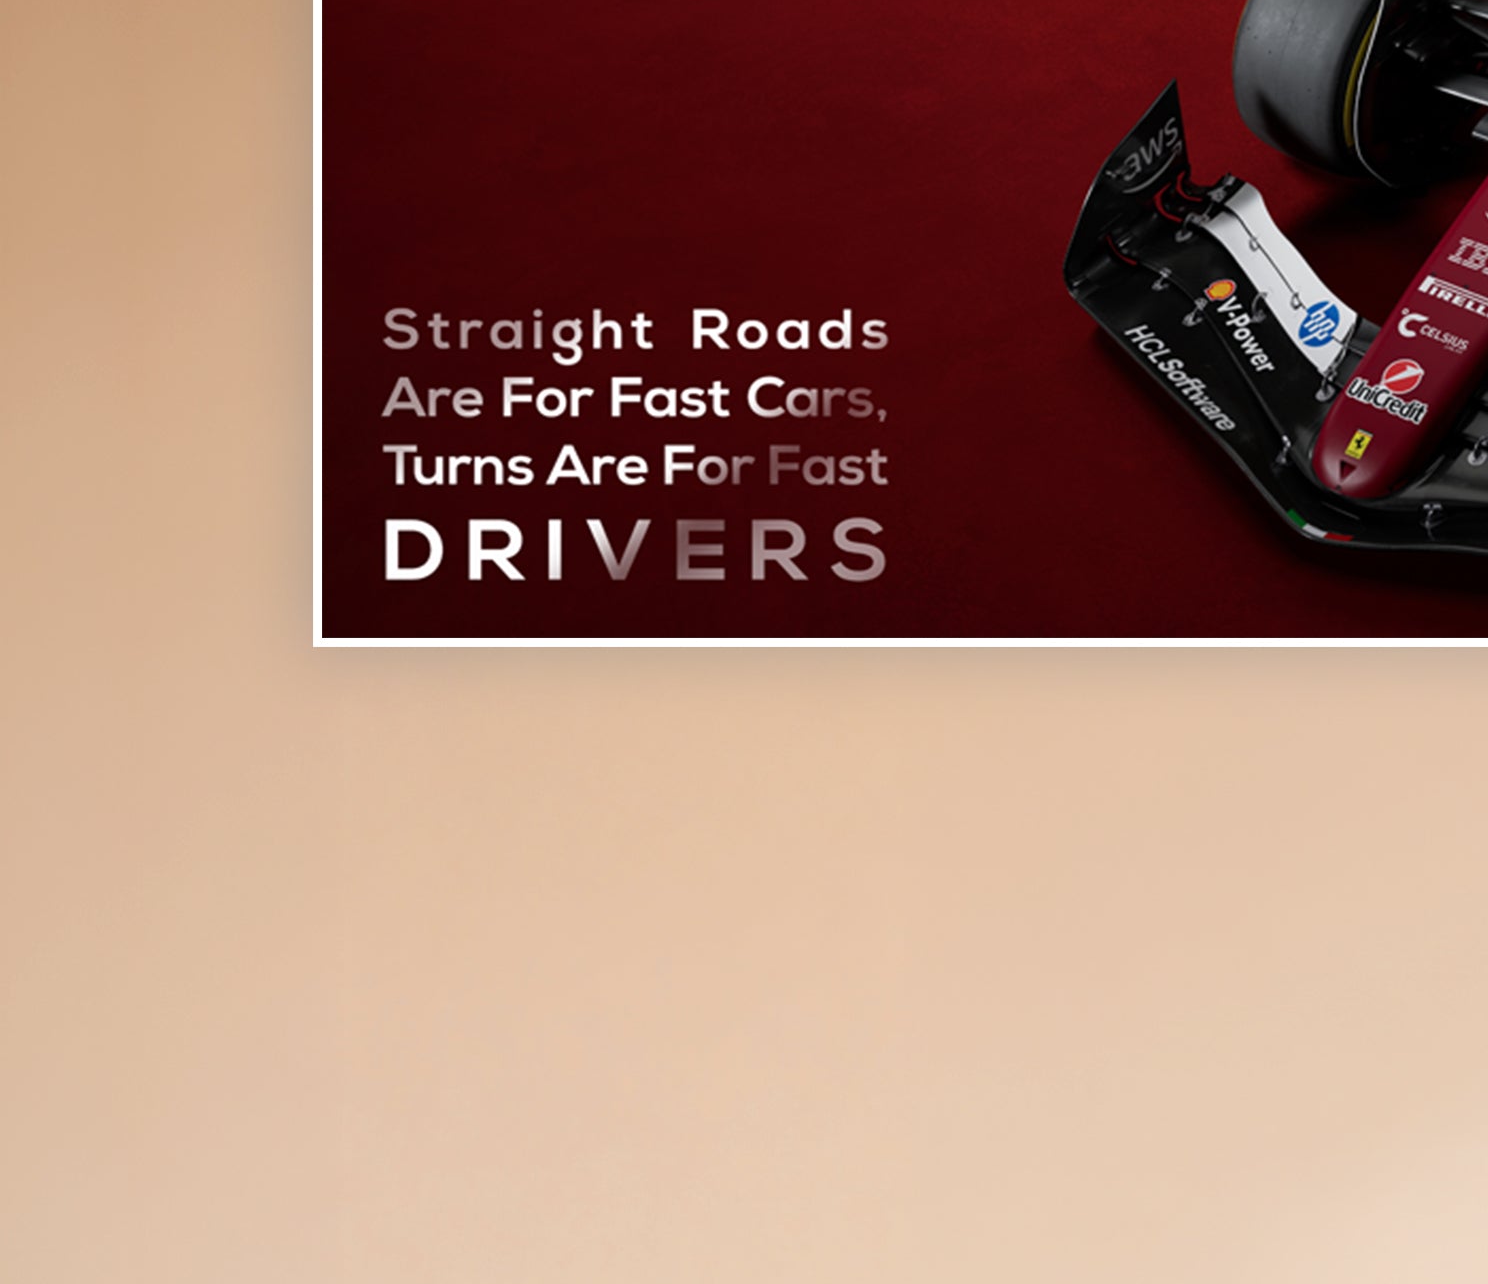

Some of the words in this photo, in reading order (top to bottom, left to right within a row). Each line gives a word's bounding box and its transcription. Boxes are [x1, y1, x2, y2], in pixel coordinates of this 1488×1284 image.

[1121, 117, 1179, 181] aws
[382, 307, 654, 366] Straight
[692, 308, 889, 350] Roads
[1217, 296, 1275, 373] V-Power
[1298, 301, 1340, 347] hp
[1420, 324, 1469, 352] CELSIUS
[382, 376, 484, 418] Are
[502, 376, 594, 418] For
[611, 376, 731, 418] Fast
[747, 375, 888, 422] Cars,
[1125, 325, 1236, 432] HCLSoftware
[1346, 377, 1428, 425] UniCredit
[382, 444, 534, 486] Turns
[545, 444, 649, 486] Are
[664, 444, 756, 486] For
[769, 444, 889, 486] Fast
[384, 517, 888, 583] DRIVERS
